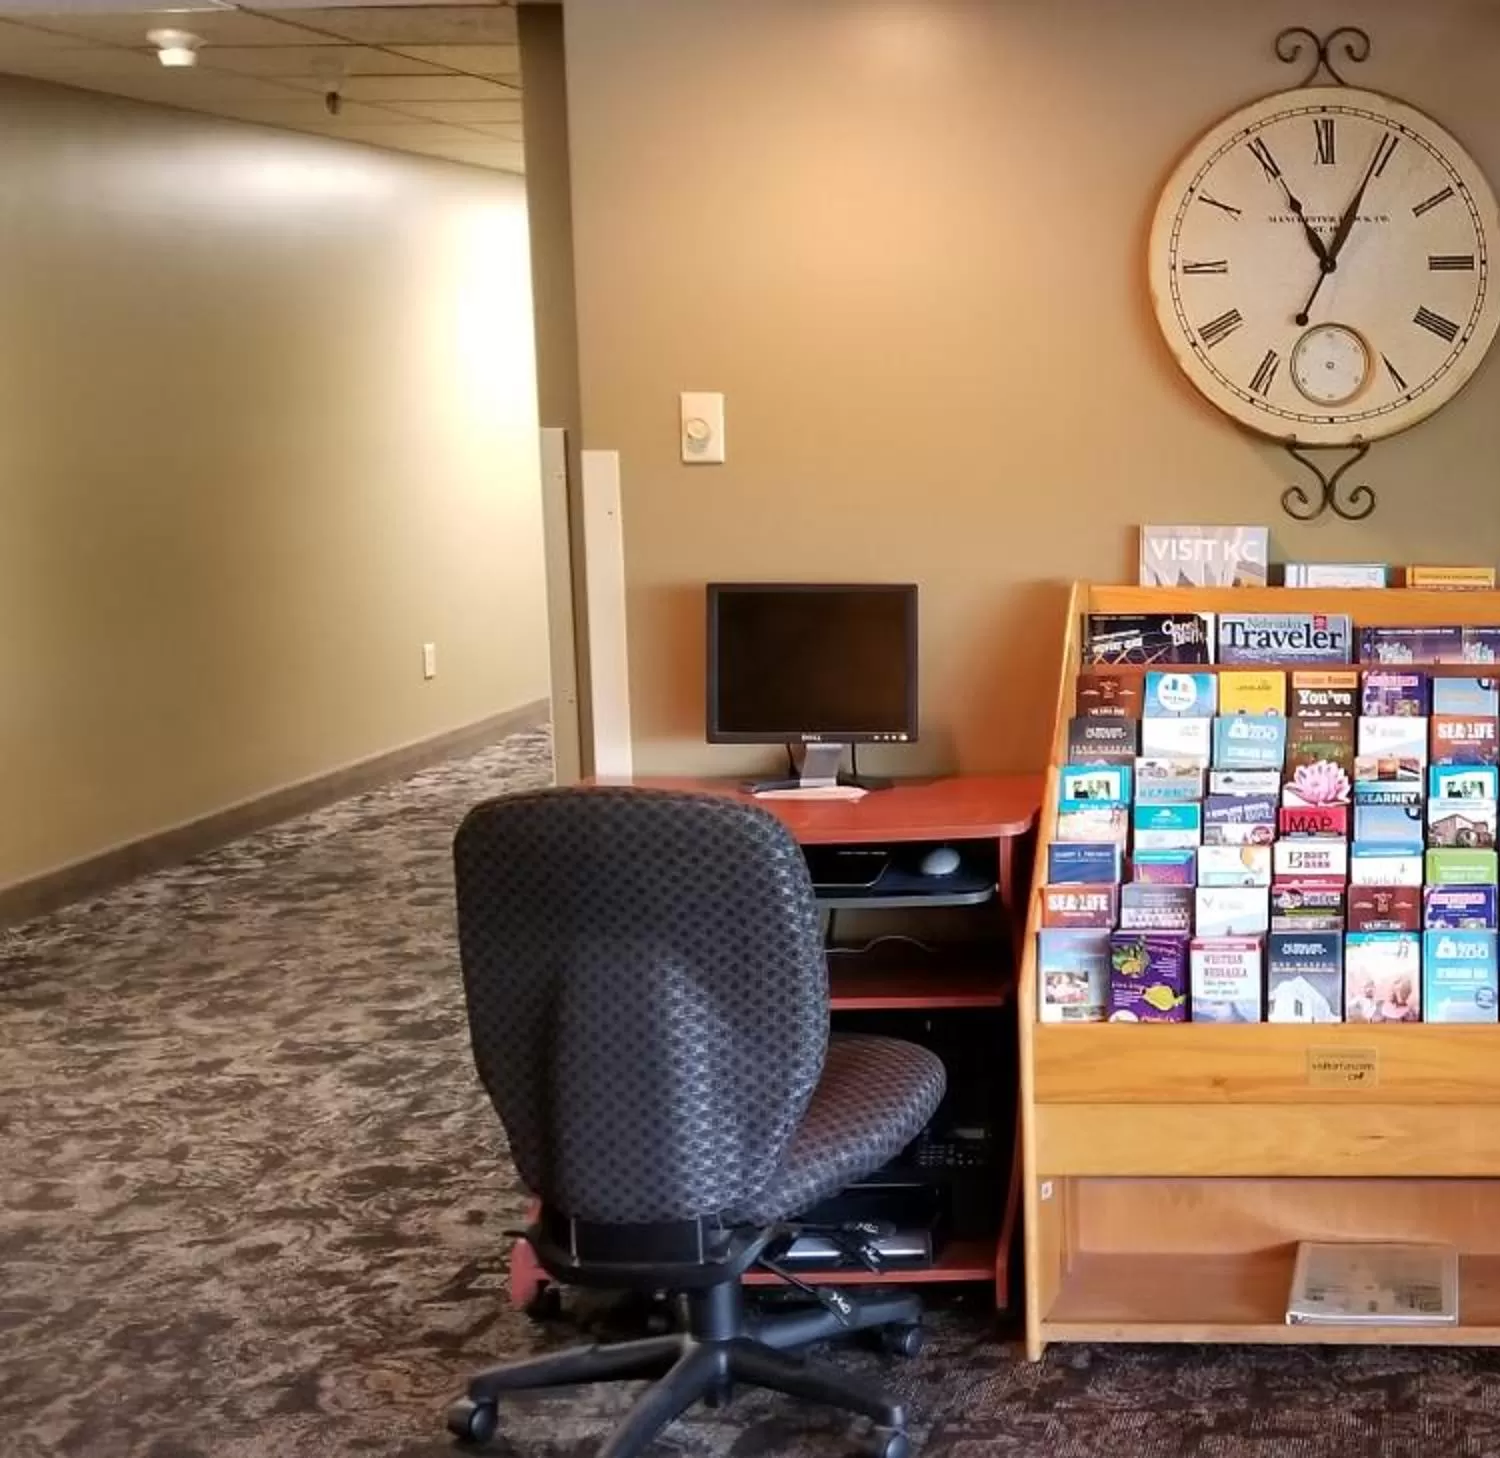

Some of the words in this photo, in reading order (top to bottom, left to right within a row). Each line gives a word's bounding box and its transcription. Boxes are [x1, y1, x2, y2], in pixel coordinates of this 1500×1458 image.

[1150, 539, 1218, 561] VISIT
[1223, 539, 1261, 562] KC
[1222, 621, 1343, 649] Traveler
[1298, 690, 1352, 705] You've
[1437, 723, 1465, 739] SEA
[1467, 723, 1495, 739] LIFE
[1359, 792, 1417, 803] KEARNEY
[1289, 816, 1333, 833] MAP
[1048, 894, 1076, 911] SEA
[1077, 894, 1109, 911] LIFE
